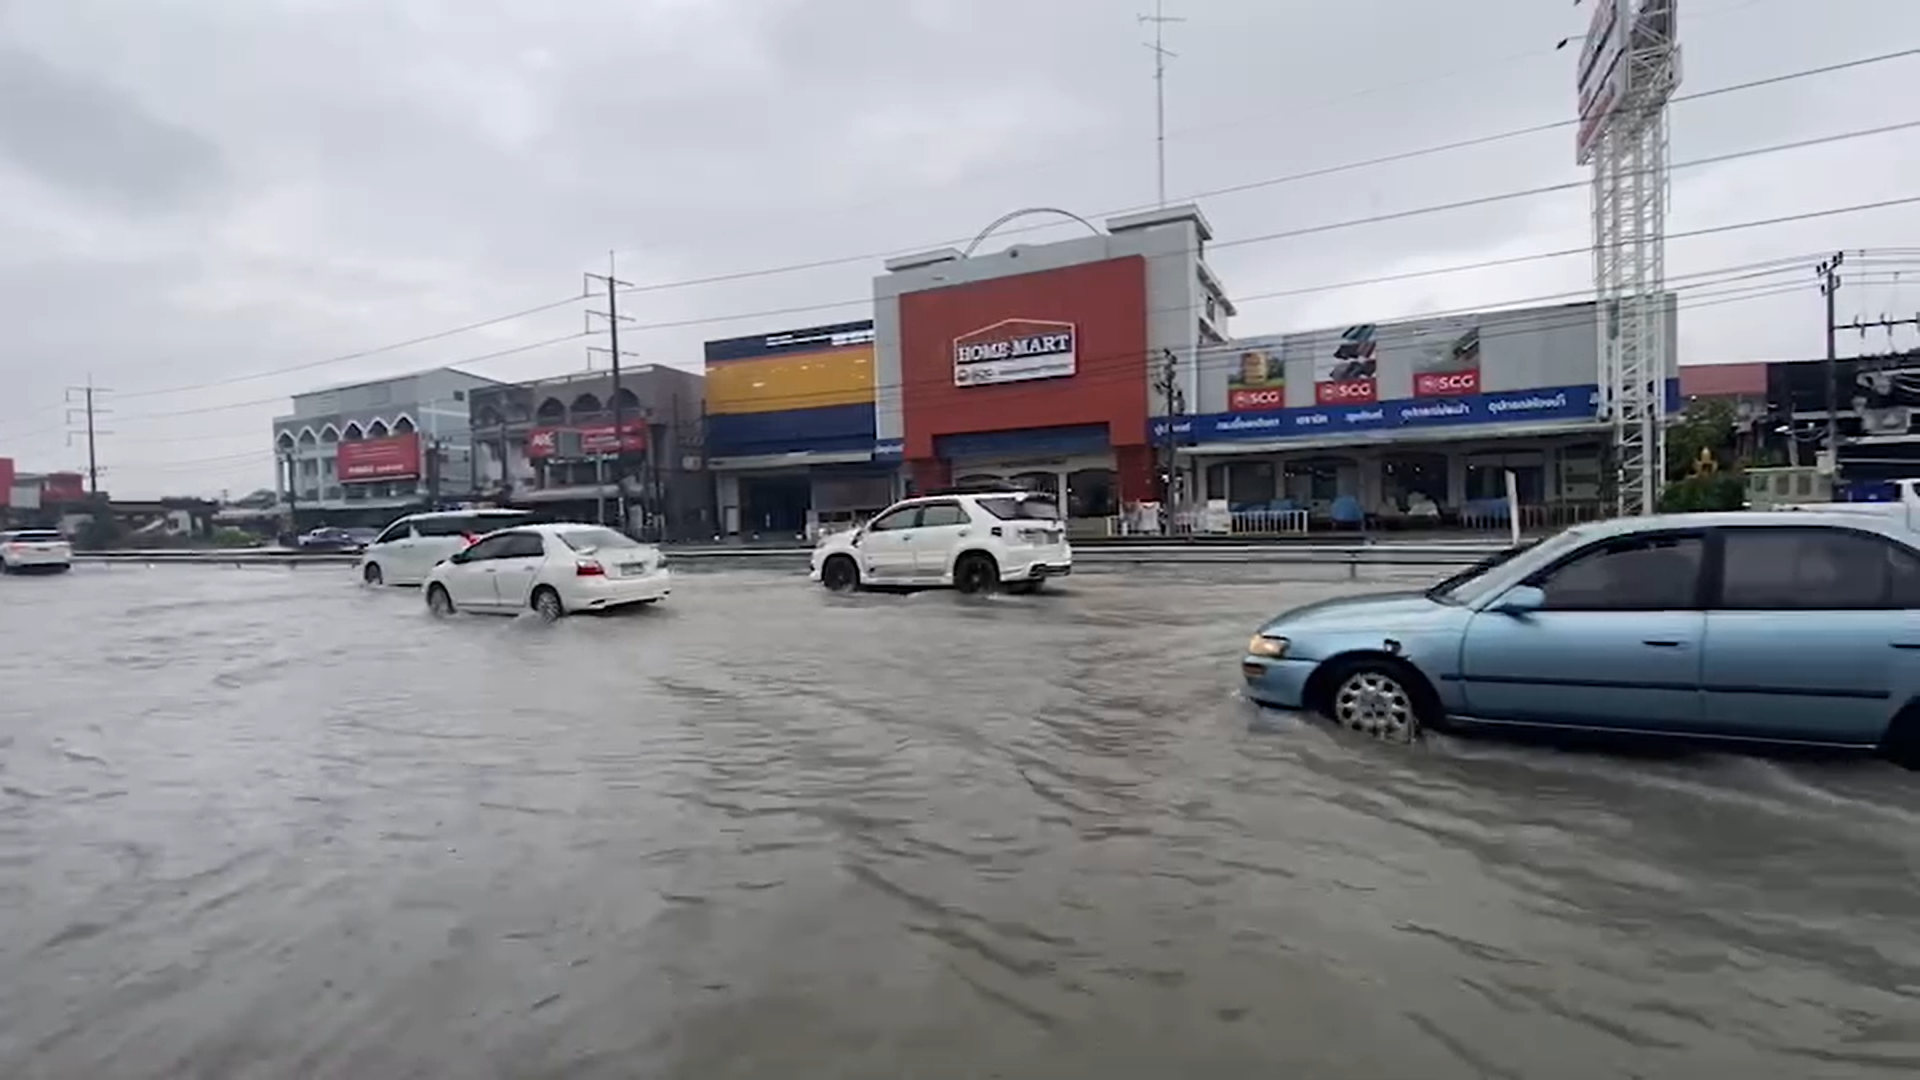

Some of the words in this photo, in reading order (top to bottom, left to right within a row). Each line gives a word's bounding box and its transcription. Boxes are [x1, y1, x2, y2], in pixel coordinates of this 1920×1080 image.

[958, 343, 1010, 361] HOME
[1012, 335, 1069, 355] MART
[1339, 383, 1371, 396] SCG
[1440, 375, 1475, 390] SCG
[1250, 391, 1279, 403] SCG
